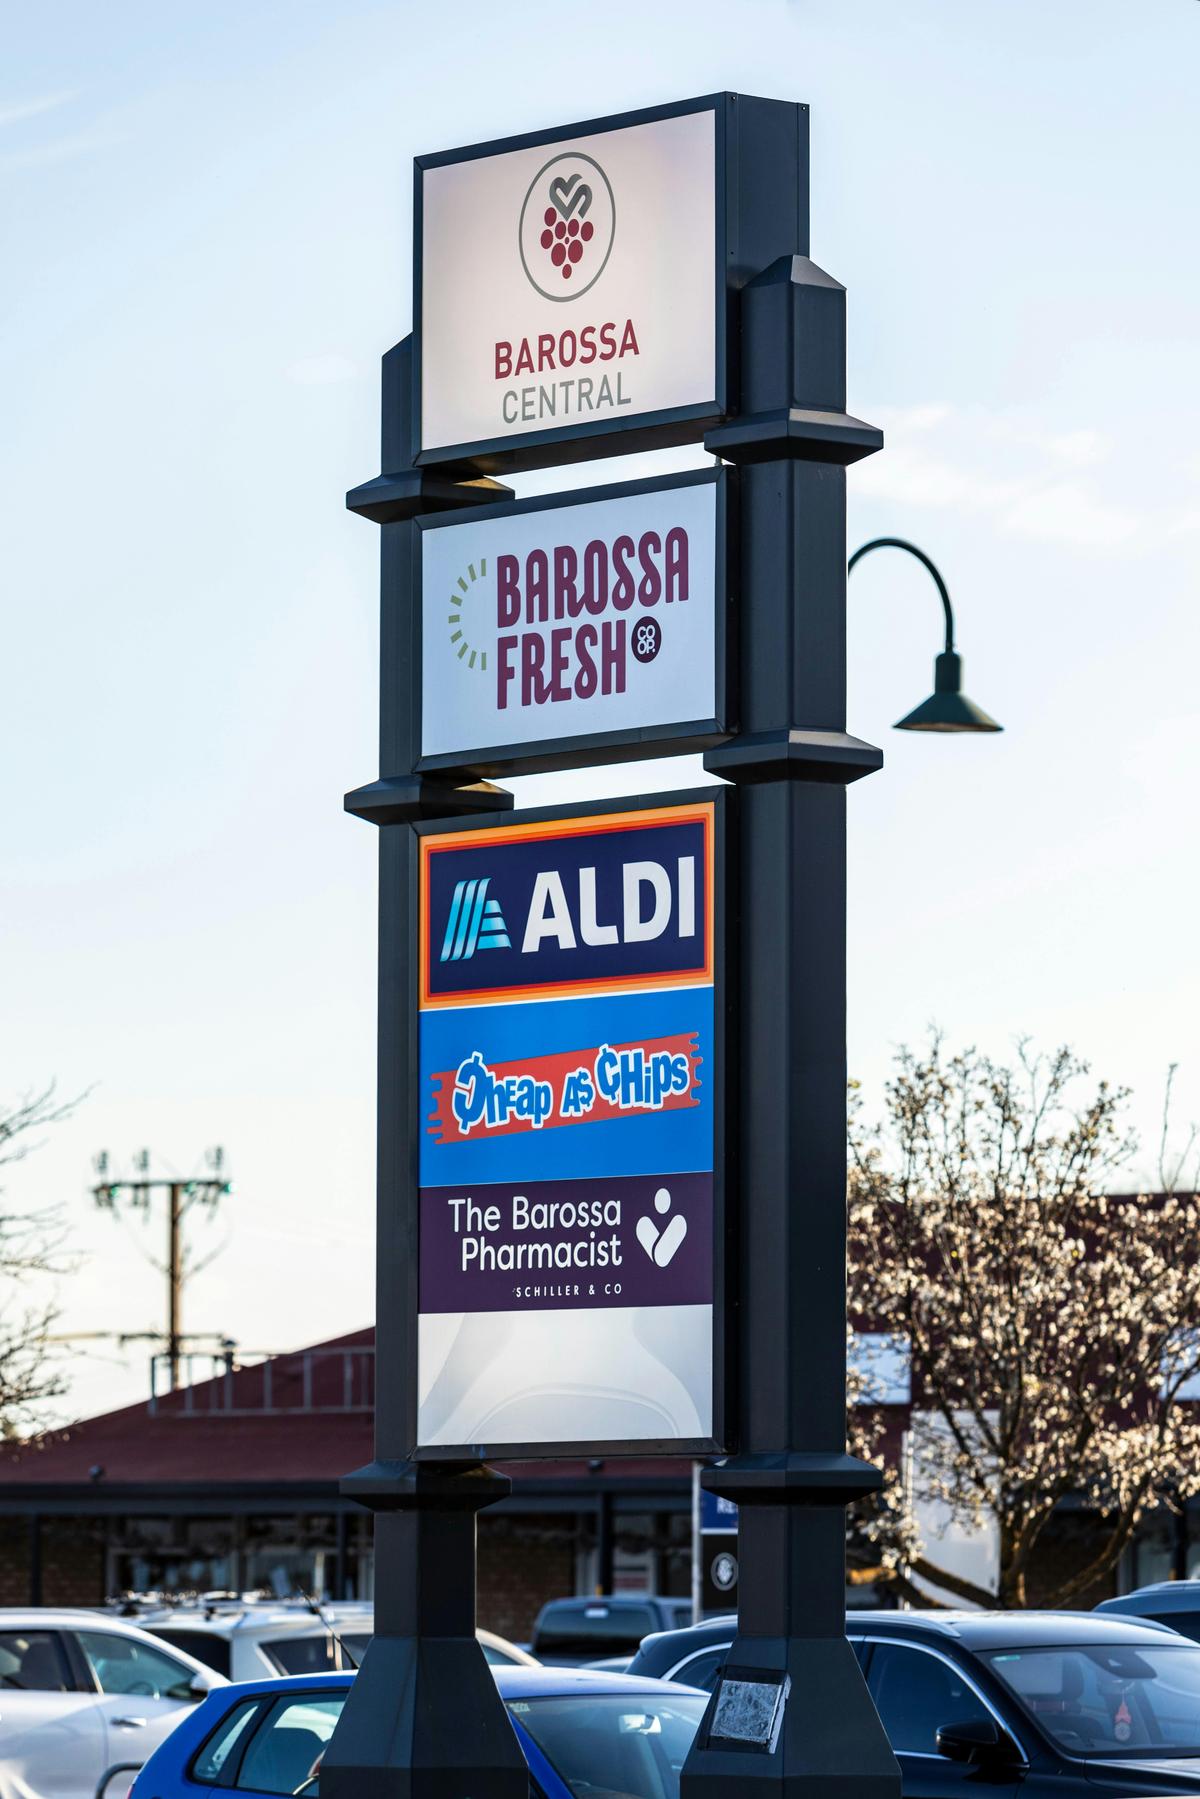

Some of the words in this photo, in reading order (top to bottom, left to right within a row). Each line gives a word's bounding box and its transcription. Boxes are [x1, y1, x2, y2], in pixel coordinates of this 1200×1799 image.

[495, 318, 640, 379] BAROSSA
[502, 371, 632, 424] CENTRAL
[497, 526, 689, 629] BAROSSA
[497, 619, 627, 710] FRESH
[521, 855, 696, 954] ALDI
[447, 1197, 501, 1233] The
[512, 1195, 622, 1231] Barossa
[461, 1231, 623, 1272] Pharmacist
[515, 1284, 580, 1298] SCHILLER
[588, 1284, 596, 1296] &
[604, 1283, 622, 1295] CO
